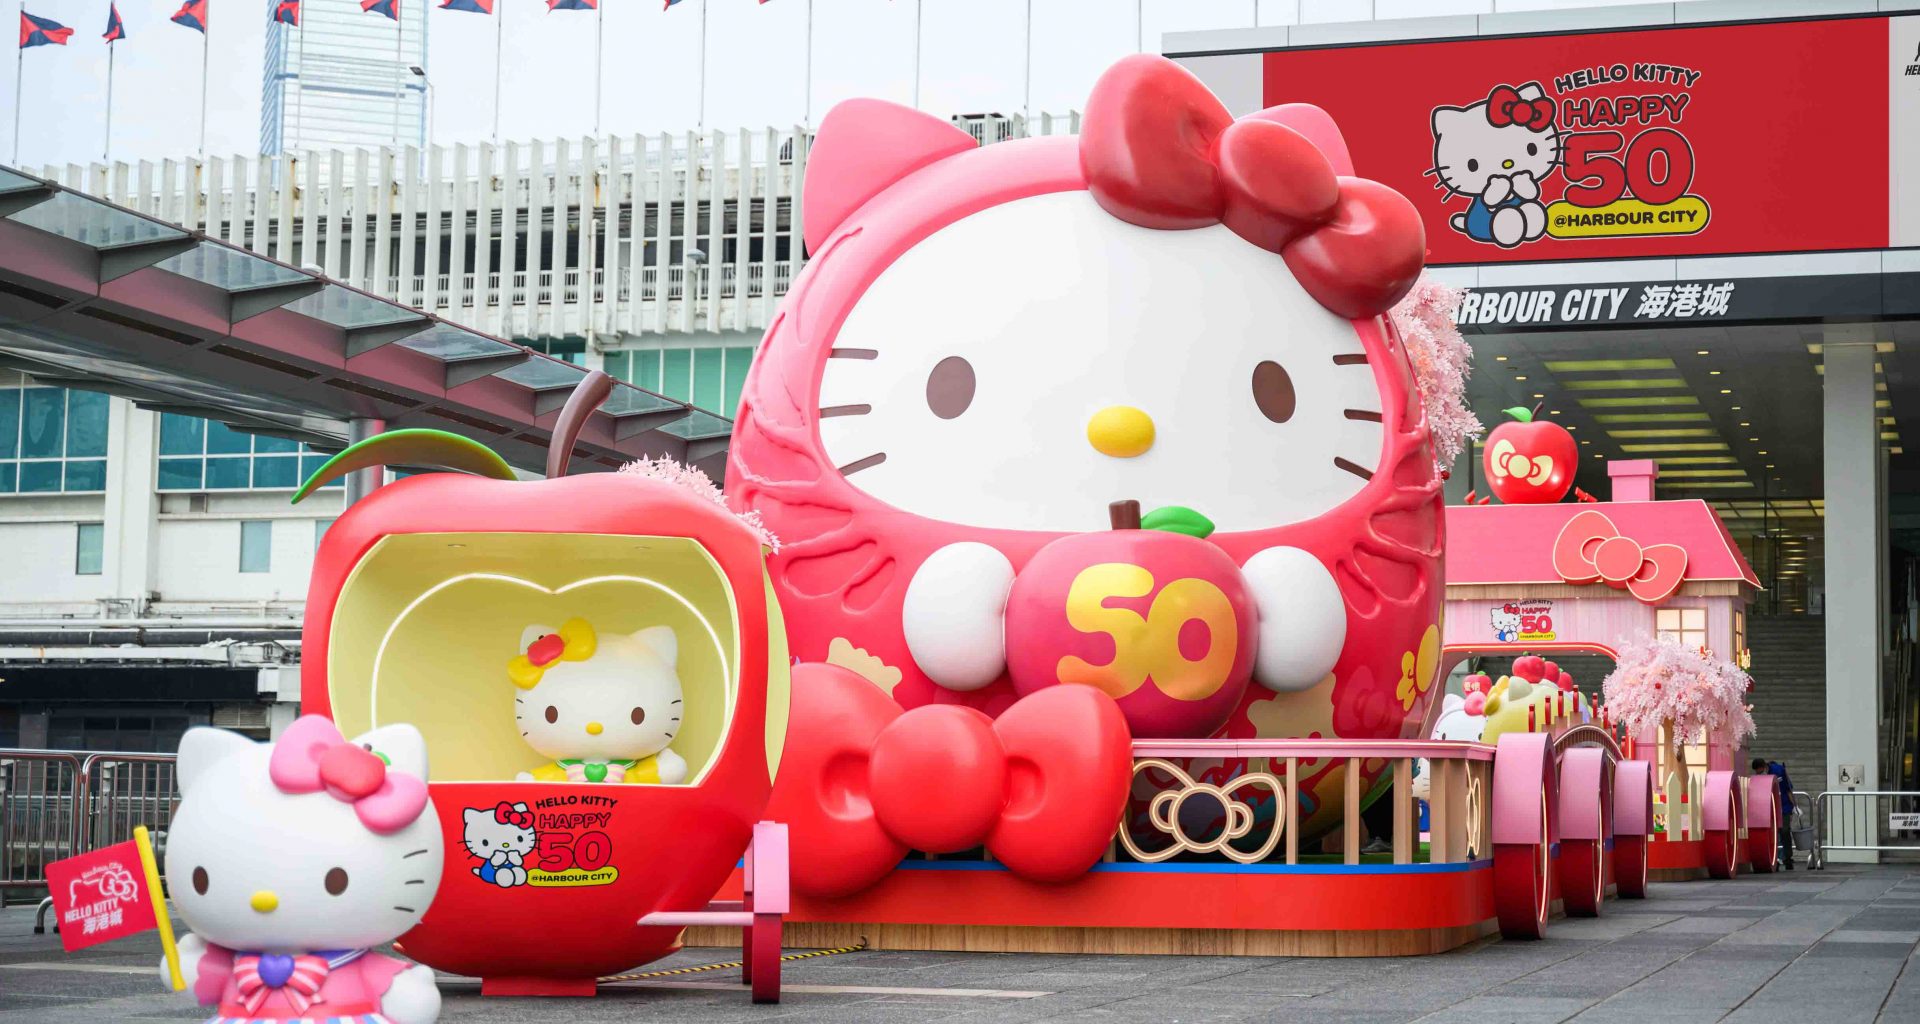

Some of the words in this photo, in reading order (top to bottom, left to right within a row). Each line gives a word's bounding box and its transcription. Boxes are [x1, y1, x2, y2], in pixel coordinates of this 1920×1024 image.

[1554, 63, 1629, 94] HELLO
[1633, 63, 1701, 88] KITTY
[1562, 93, 1690, 128] HAPPY
[1562, 127, 1695, 208] 50
[1554, 211, 1653, 228] @HARBOUR
[1658, 210, 1697, 223] CITY
[1560, 287, 1631, 322] CITY
[1634, 282, 1734, 319] 海港城
[1056, 562, 1238, 702] 50
[1522, 615, 1552, 634] 50
[535, 795, 577, 810] HELLO
[581, 795, 618, 808] KITTY
[539, 812, 611, 829] HAPPY
[537, 830, 612, 872] 50
[532, 874, 589, 882] @HARBOUR
[590, 872, 613, 880] CITY
[65, 904, 92, 924] HELLO
[93, 898, 119, 915] KITTY
